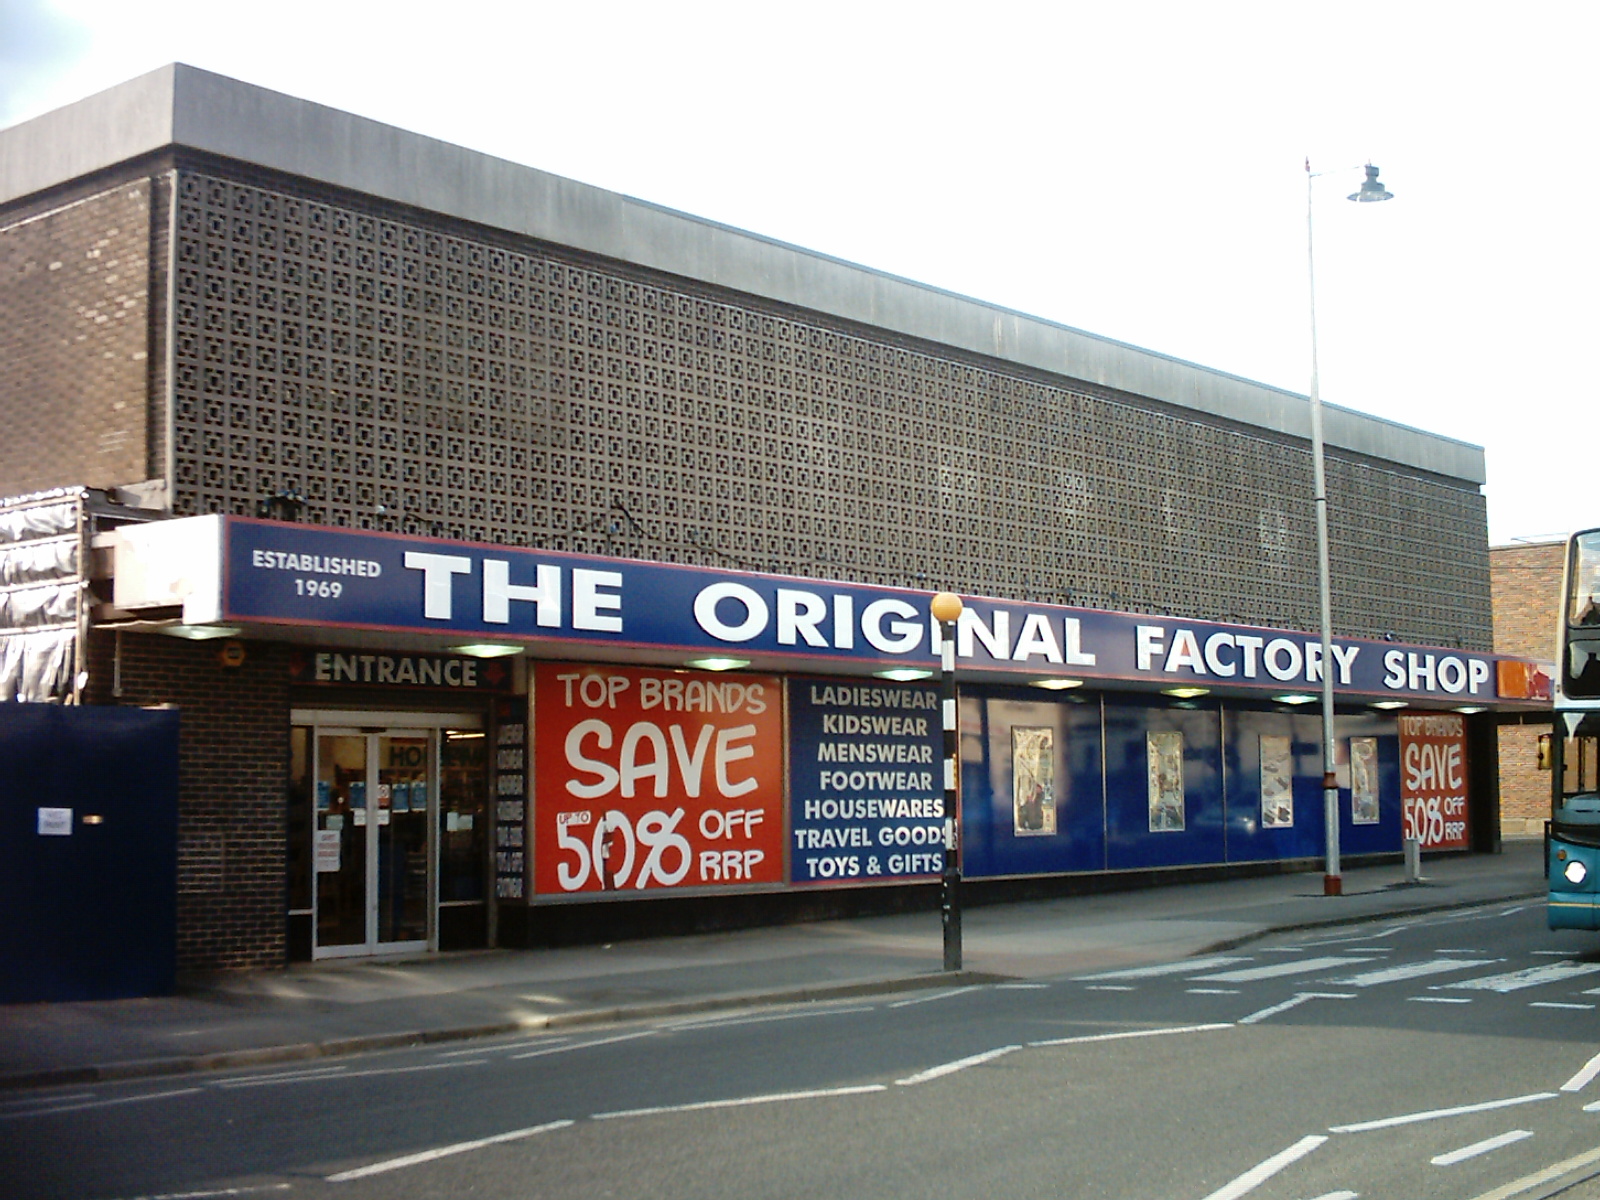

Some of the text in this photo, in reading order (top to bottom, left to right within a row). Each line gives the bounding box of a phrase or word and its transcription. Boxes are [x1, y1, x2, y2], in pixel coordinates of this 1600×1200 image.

[252, 550, 382, 577] ESTABLISHED
[294, 579, 343, 599] 1969
[404, 551, 623, 633] THE
[1135, 625, 1360, 685] FACTORY
[1383, 649, 1490, 694] SHOP
[315, 652, 477, 688] ENTRANCE
[557, 673, 767, 715] TOP BRANDS
[811, 685, 938, 711] LADIESWEAR
[823, 714, 928, 737] KIDSWEAR
[1402, 715, 1423, 736] TOP
[564, 718, 759, 799] SAVE
[817, 742, 933, 764] MENSWEAR
[1405, 742, 1463, 791] SAVE
[820, 770, 933, 791] FOOTWEAR
[804, 798, 945, 820] HOUSEWARES
[1404, 795, 1466, 846] 50% OFF
[795, 826, 946, 849] TRAVEL GOOD
[1445, 821, 1466, 840] RRP
[557, 807, 765, 891] 50% OFF
[699, 849, 765, 881] RRP
[806, 852, 944, 878] TOYS & GIFTS
